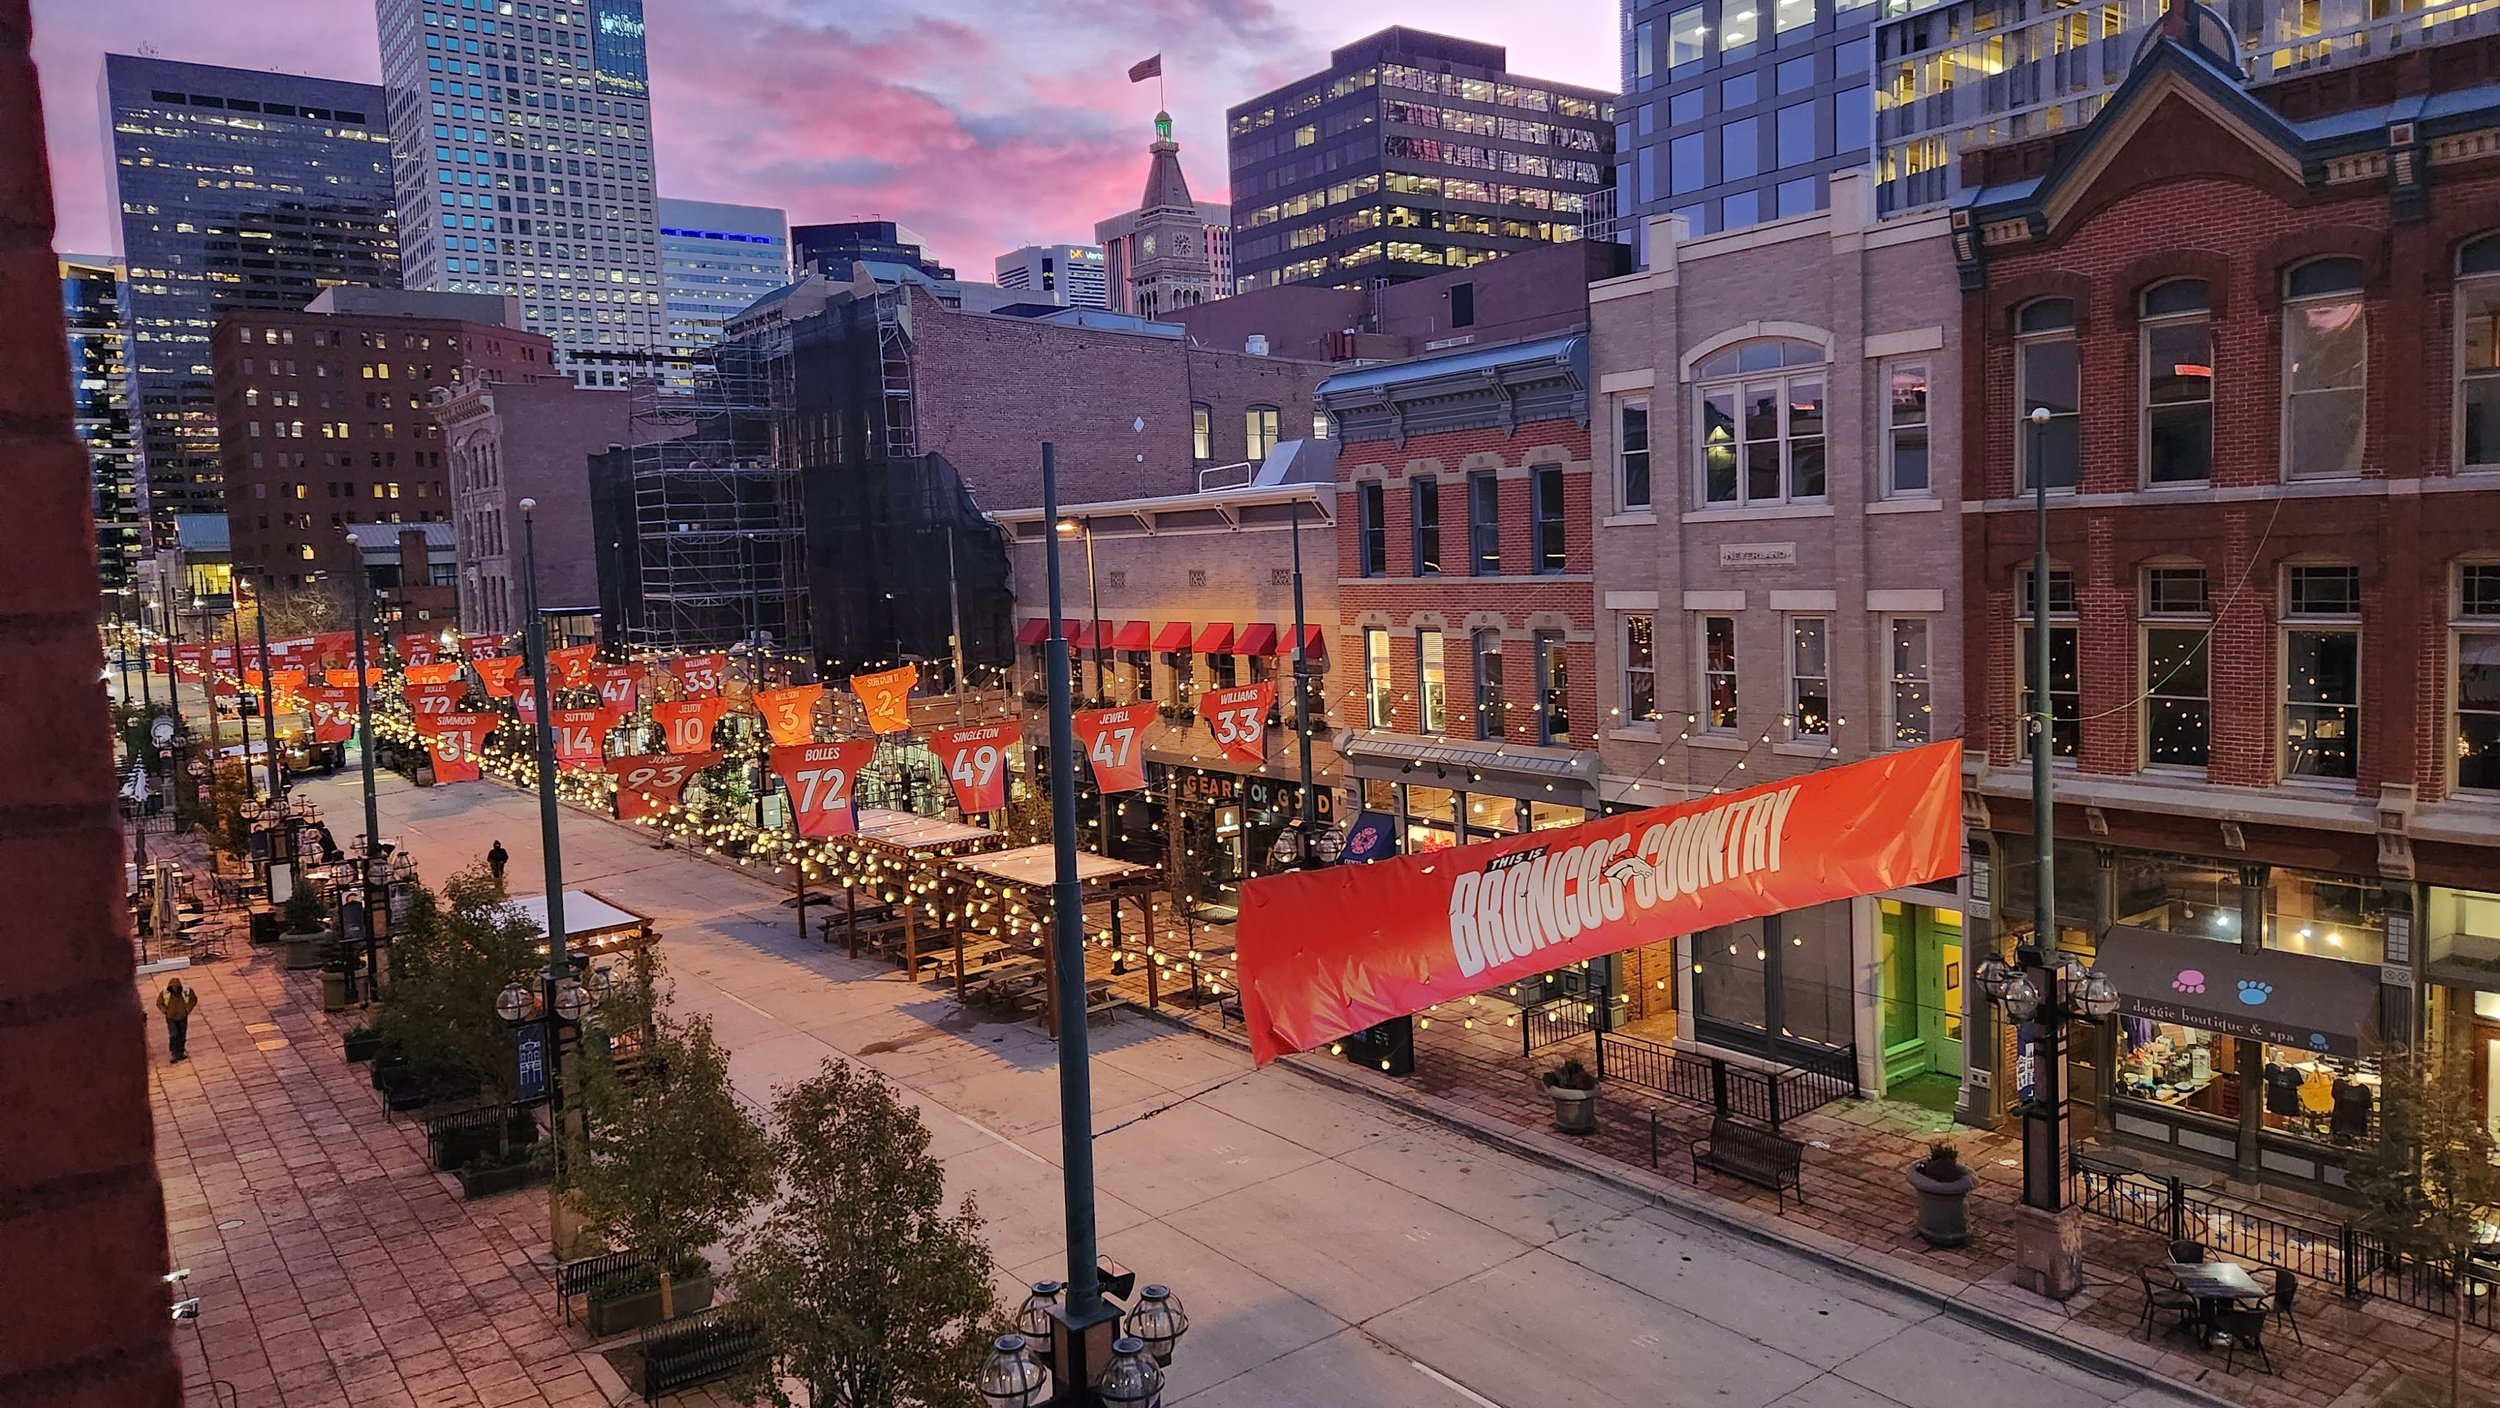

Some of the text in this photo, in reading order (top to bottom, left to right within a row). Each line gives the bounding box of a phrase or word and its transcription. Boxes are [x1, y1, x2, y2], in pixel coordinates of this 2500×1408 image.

[1726, 551, 1787, 560] NEVERLAND
[472, 646, 496, 660] 33
[491, 668, 505, 687] 3
[569, 659, 582, 677] 2
[602, 678, 631, 701] 47
[685, 669, 715, 692] 33
[867, 675, 893, 688] SURTAIN
[420, 696, 450, 714] 72
[877, 690, 895, 717] 2
[1220, 689, 1258, 705] WILLIAMS
[314, 702, 349, 725] 93
[437, 716, 477, 726] SIMMONS
[564, 712, 595, 723] SUTTON
[778, 703, 799, 731] 3
[1099, 710, 1130, 725] JEWELL
[674, 717, 704, 746] 10
[952, 727, 999, 743] SINGLETON
[1217, 707, 1261, 744] 33
[438, 730, 472, 762] 31
[562, 726, 594, 756] 14
[1092, 727, 1135, 768] 47
[804, 747, 840, 762] BOLLES
[626, 765, 688, 791] 93
[951, 745, 998, 788] 49
[796, 768, 847, 813] 72
[1187, 775, 1231, 797] GEAR
[1278, 788, 1330, 813] GOD
[1490, 848, 1545, 870] THIS IS
[1450, 784, 1802, 978] BRONCOS COUNTRY
[2133, 1000, 2294, 1042] doggie boutique & spa
